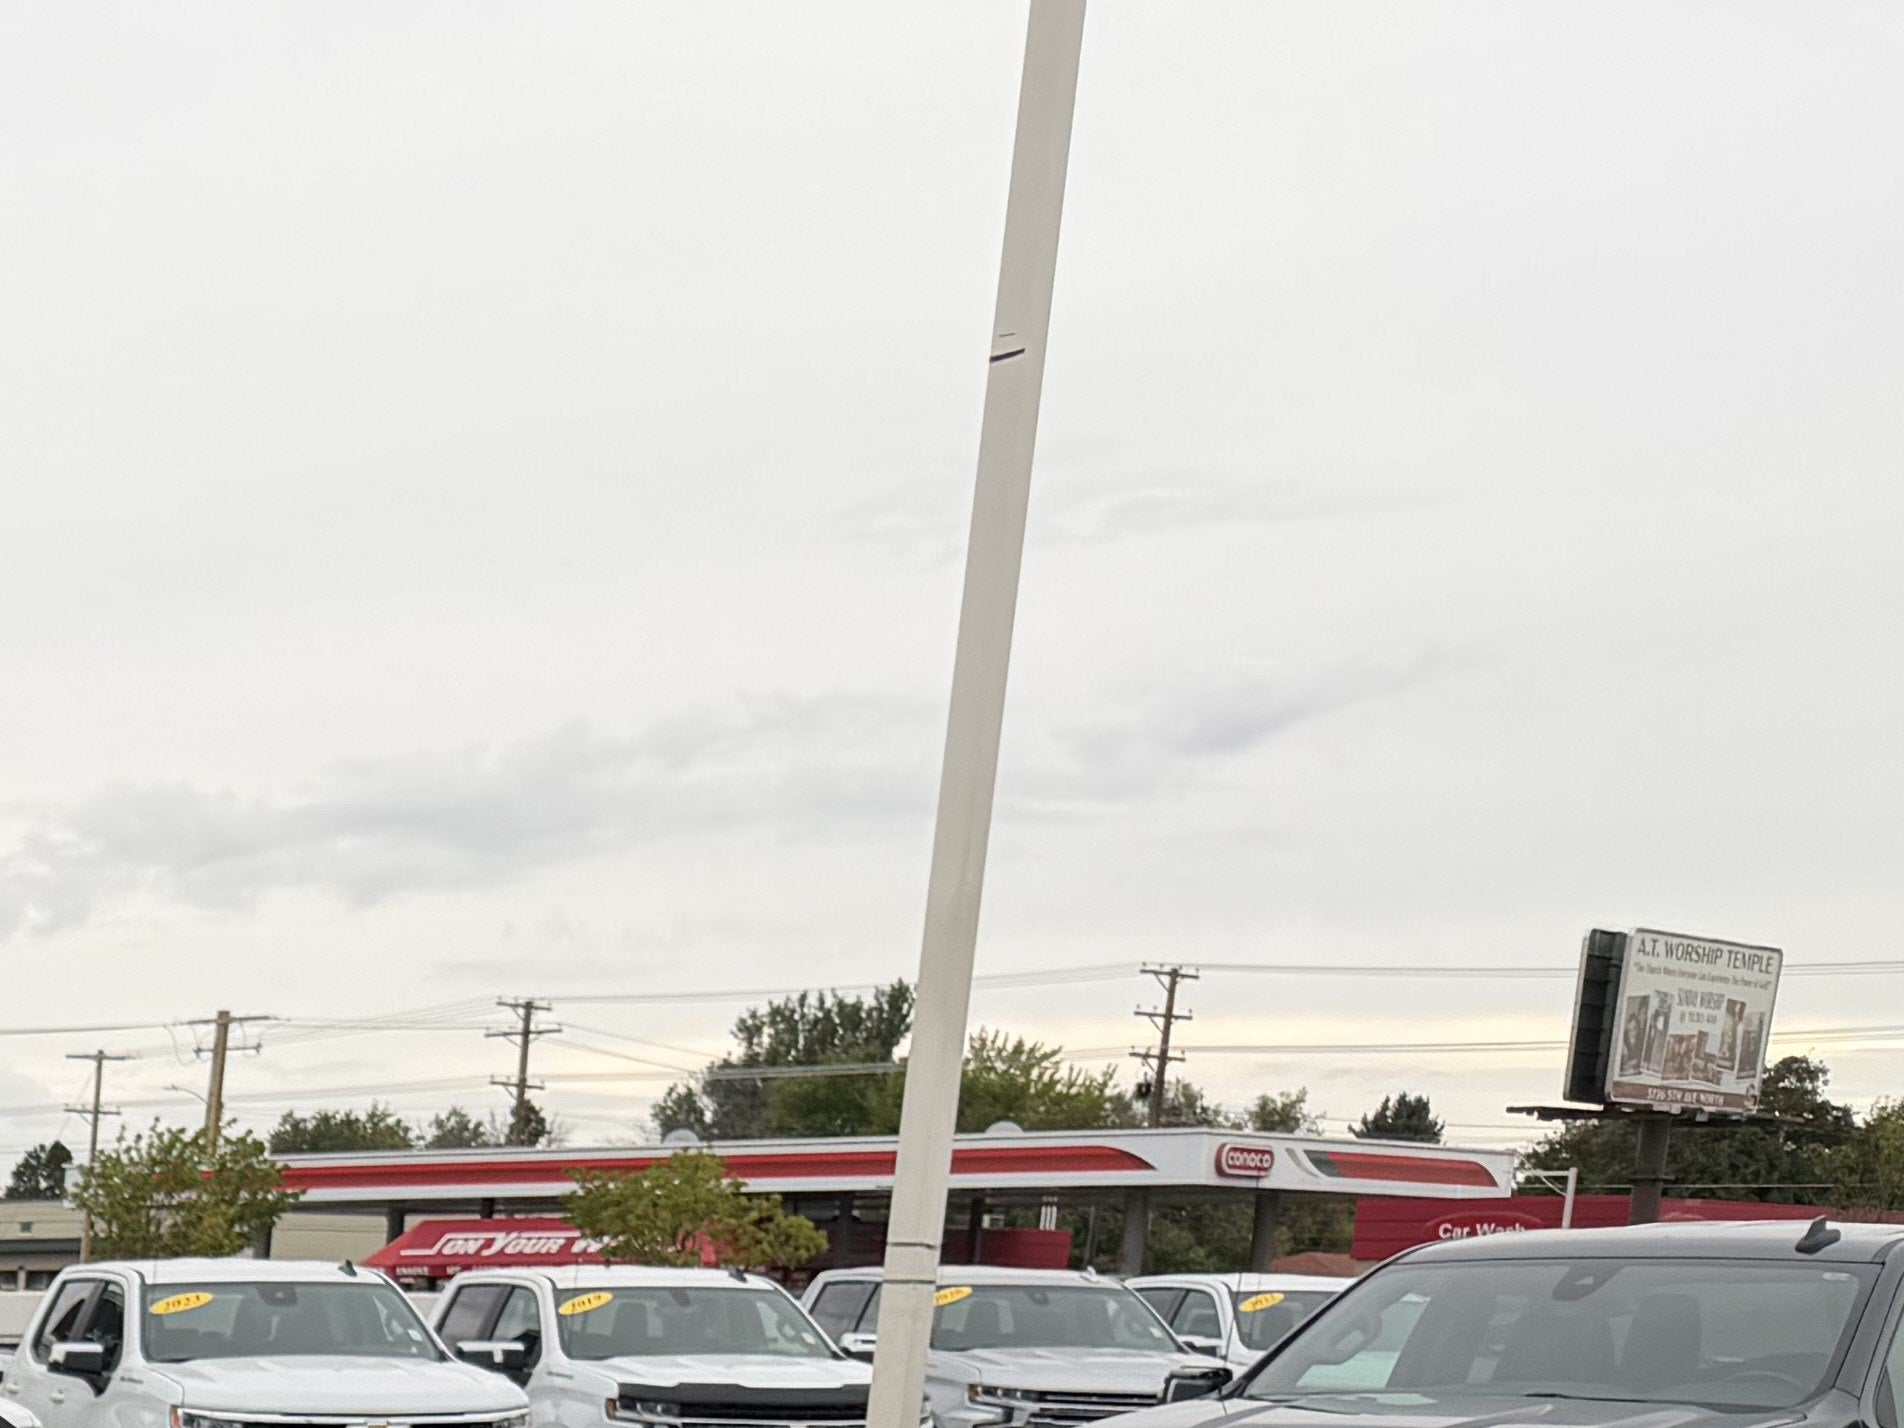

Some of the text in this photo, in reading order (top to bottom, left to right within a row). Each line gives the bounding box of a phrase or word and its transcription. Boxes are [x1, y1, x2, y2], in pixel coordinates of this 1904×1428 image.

[1637, 937, 1774, 975] A.T. WORSHIP TEMPLE
[1438, 1223, 1470, 1239] Car
